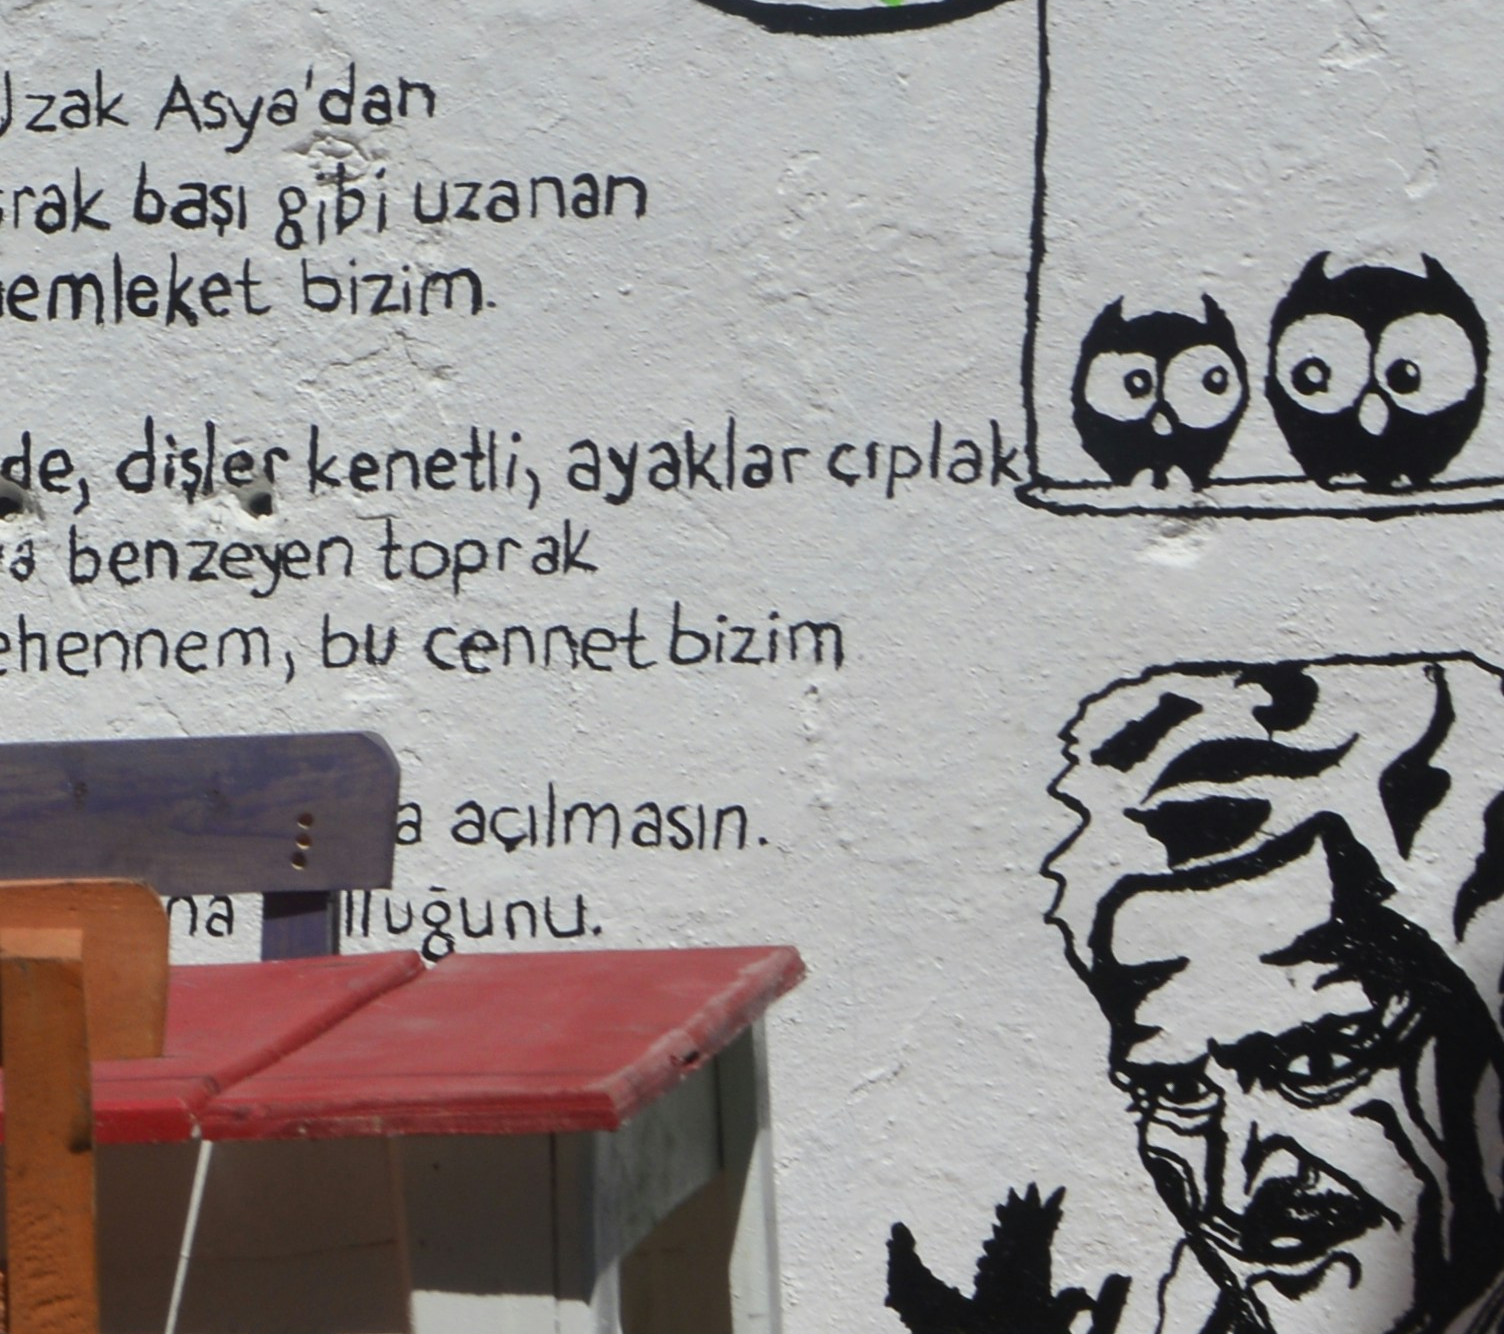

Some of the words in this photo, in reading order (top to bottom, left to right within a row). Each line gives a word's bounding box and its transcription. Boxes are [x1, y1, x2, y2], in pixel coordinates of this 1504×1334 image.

[155, 63, 436, 154] Asya'dan
[133, 163, 247, 236] başı
[275, 162, 387, 251] gibi
[414, 173, 647, 224] uzanan
[301, 259, 496, 316] bizim.
[116, 416, 289, 506] dişler
[307, 424, 540, 509] kenetli,
[567, 418, 809, 506] ayaklar
[69, 525, 353, 599] benzeyen
[380, 519, 597, 593] toprak
[322, 614, 397, 669] bu
[423, 608, 653, 674] cennet
[669, 602, 844, 667] bizim
[451, 784, 767, 853] açılmasın.
